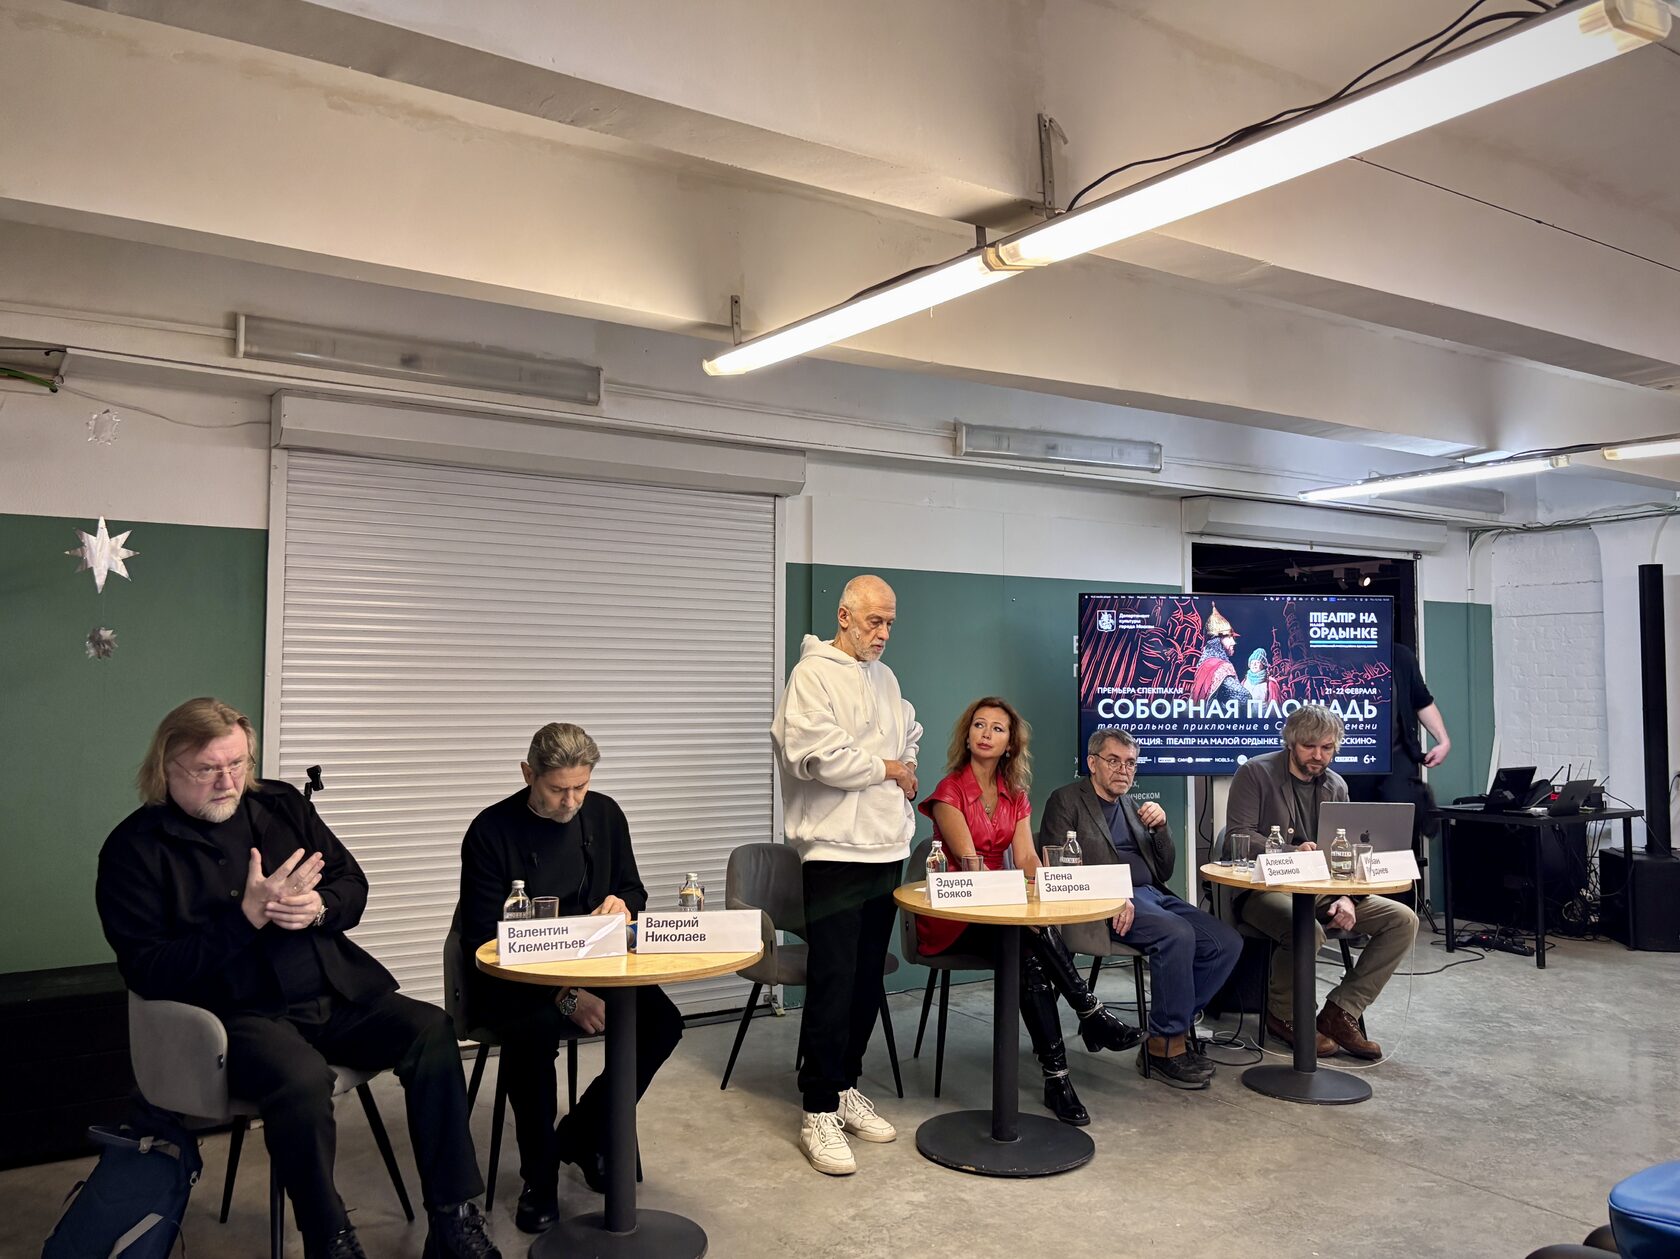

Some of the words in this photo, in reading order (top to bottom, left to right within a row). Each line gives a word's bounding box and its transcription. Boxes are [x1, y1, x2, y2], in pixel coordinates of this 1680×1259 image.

[1360, 612, 1378, 623] НА
[1309, 627, 1378, 640] ОРДЫНКЕ
[1345, 687, 1377, 695] ФЕВРАЛЯ
[1097, 698, 1239, 719] СОБОРНАЯ
[1247, 699, 1378, 721] ПЛОАДЬ
[1097, 723, 1178, 732] театральное
[1183, 723, 1258, 732] приключение
[1210, 737, 1240, 745] МАЛОЙ
[1241, 738, 1279, 746] ОРДЫНКЕ
[1363, 754, 1377, 764] 6+
[1265, 856, 1294, 866] Алексей
[1044, 871, 1073, 881] Елена
[1267, 868, 1300, 877] Зензинов
[935, 877, 973, 889] Эдуард
[1045, 883, 1090, 893] Захарова
[937, 889, 972, 899] Бояков
[645, 916, 699, 930] Валерий
[507, 925, 569, 939] Валентин
[645, 931, 706, 942] Николаев
[508, 939, 586, 954] Клементьев
